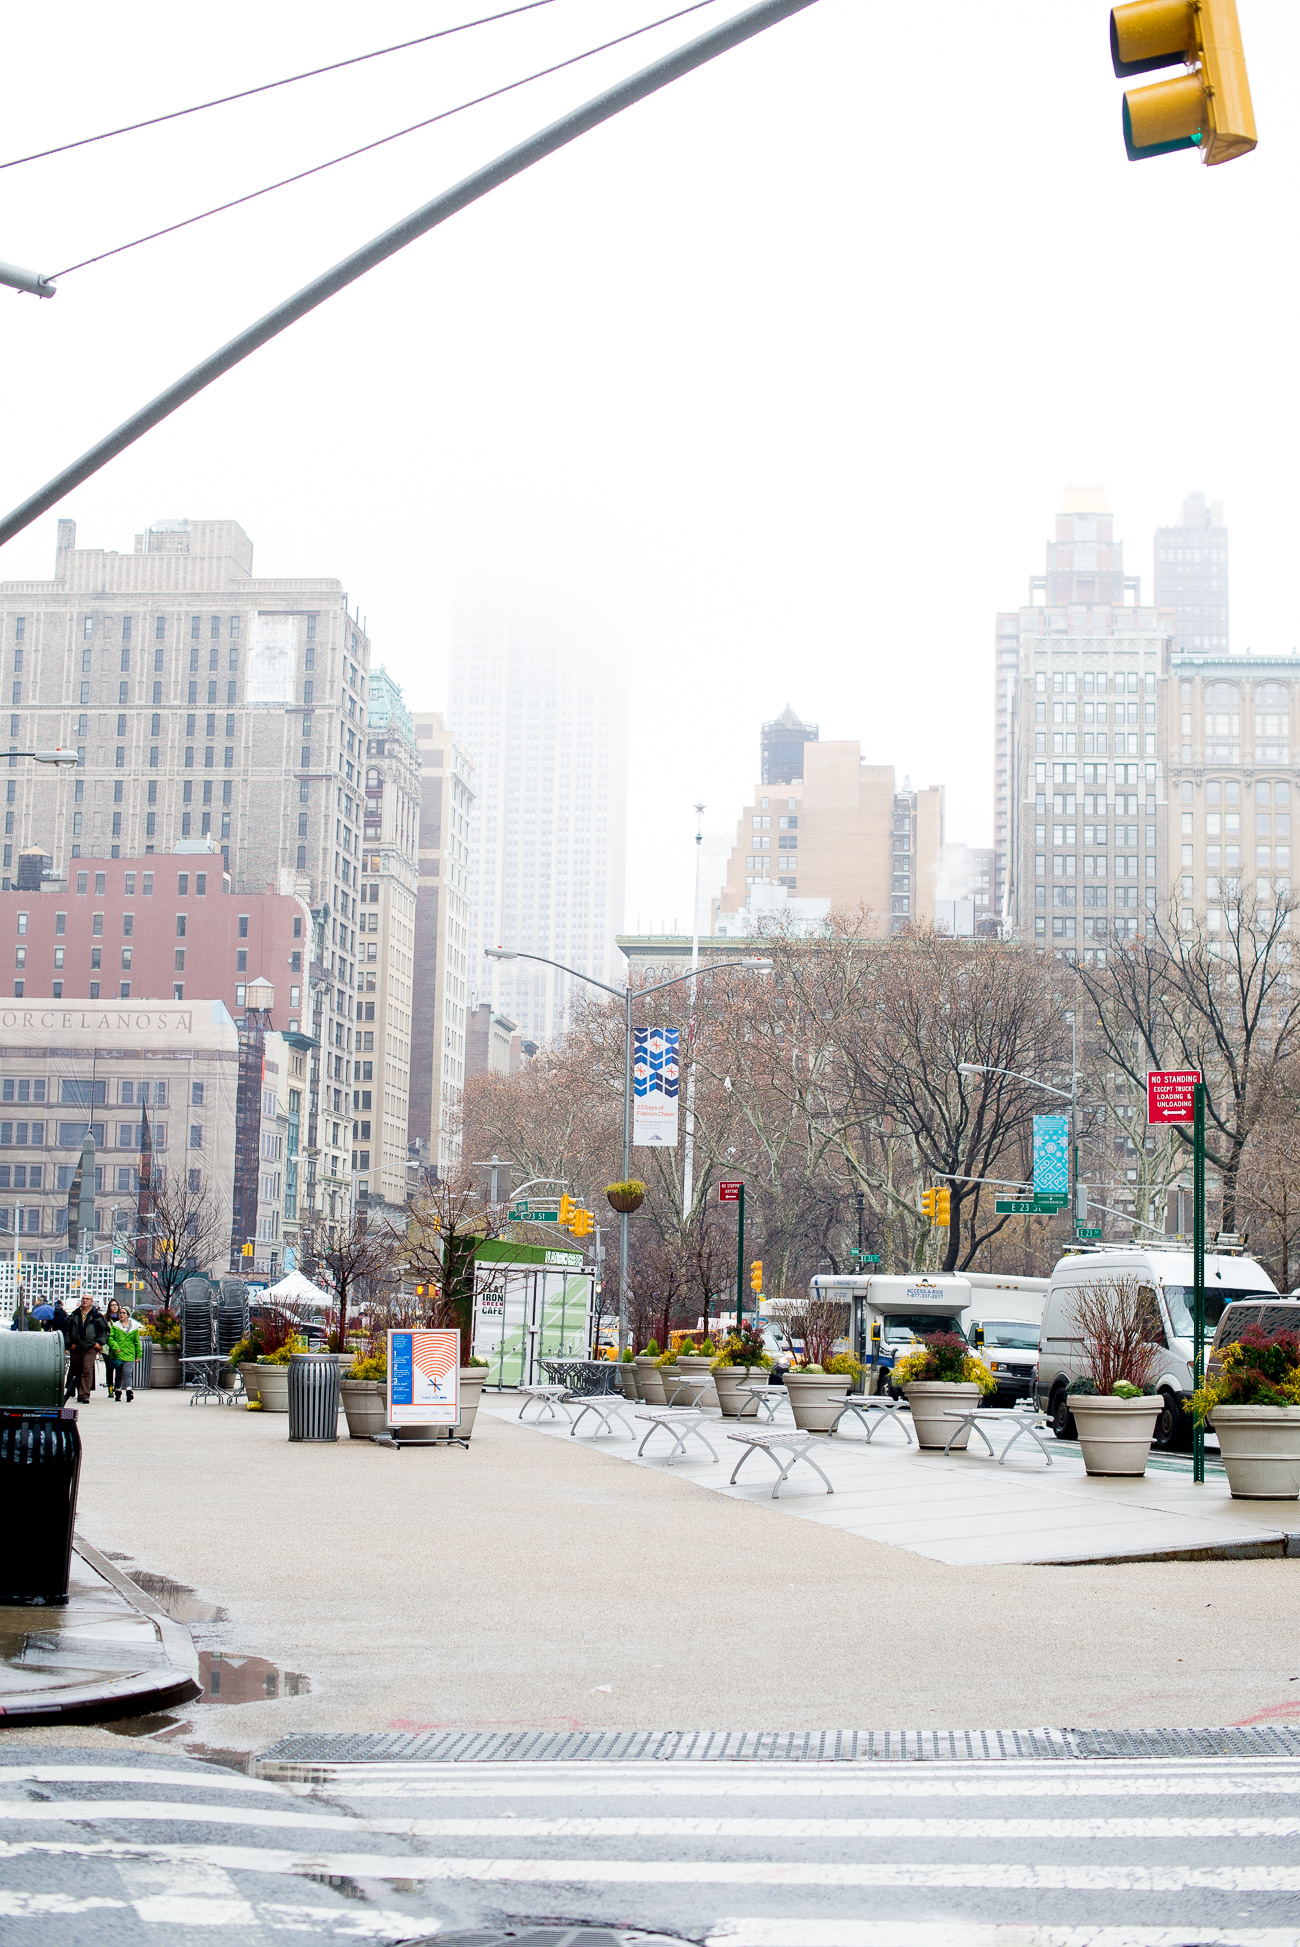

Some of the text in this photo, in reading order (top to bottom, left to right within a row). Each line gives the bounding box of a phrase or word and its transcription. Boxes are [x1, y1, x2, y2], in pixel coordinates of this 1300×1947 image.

[1164, 1075, 1198, 1083] STANDING
[1012, 1204, 1016, 1212] E
[1020, 1204, 1030, 1212] 23
[482, 1294, 504, 1302] IRON
[482, 1307, 502, 1315] CAFE
